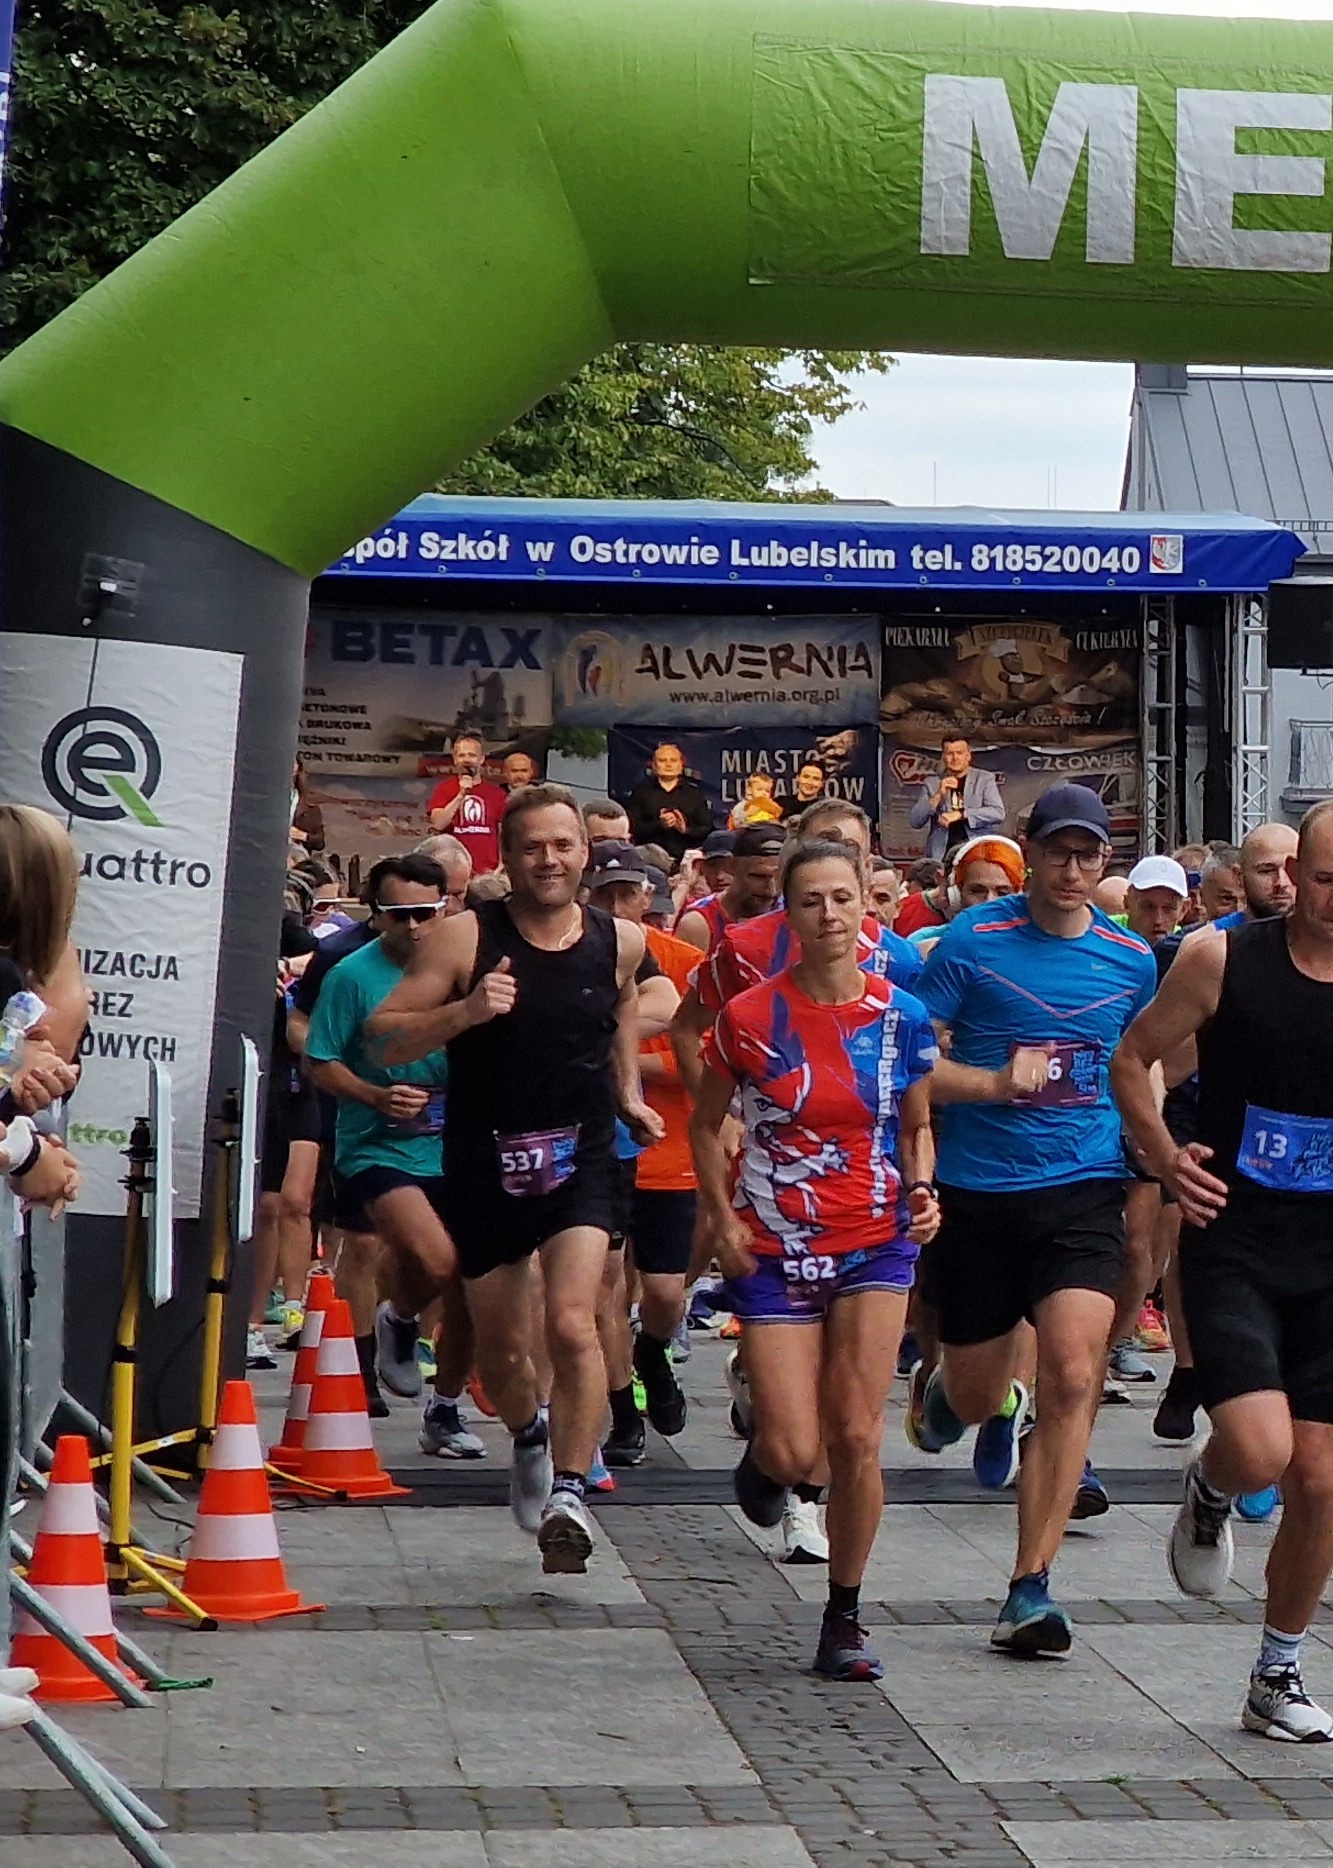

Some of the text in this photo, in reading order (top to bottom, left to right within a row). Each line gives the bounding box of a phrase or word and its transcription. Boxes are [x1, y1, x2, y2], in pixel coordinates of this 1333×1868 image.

[419, 530, 509, 560] Szkół
[526, 542, 554, 562] w
[570, 535, 720, 565] Ostrowie
[731, 539, 895, 569] Lubelskim
[910, 544, 962, 570] tel.
[971, 544, 1140, 573] 818520040
[332, 621, 543, 670] BETAX
[634, 642, 873, 681] ALWERNIA
[668, 686, 840, 705] www.alwernia.org.pl
[1047, 1056, 1063, 1081] 6
[1254, 1129, 1288, 1159] 13
[501, 1147, 544, 1173] 537
[783, 1255, 837, 1282] 562
